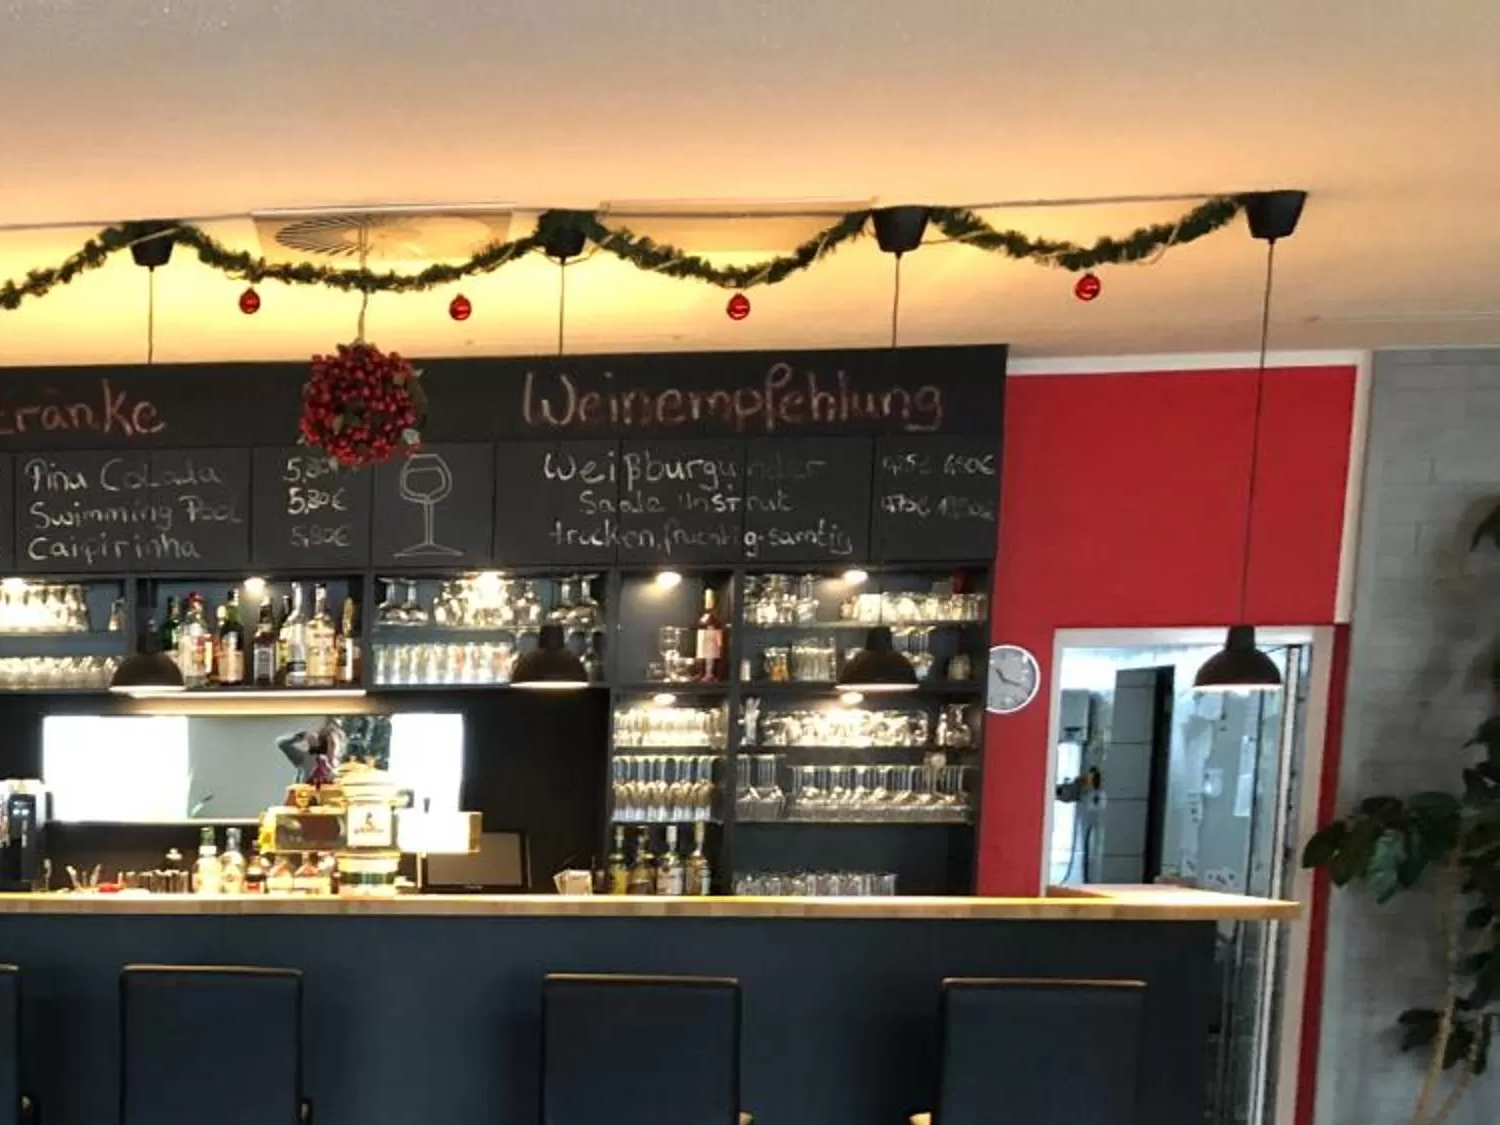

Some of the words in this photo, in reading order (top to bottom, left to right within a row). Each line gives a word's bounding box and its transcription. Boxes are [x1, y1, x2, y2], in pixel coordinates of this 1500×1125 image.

[522, 362, 944, 433] Weinempfehlung
[29, 500, 173, 531] Swimming
[27, 532, 202, 566] Caipirinha
